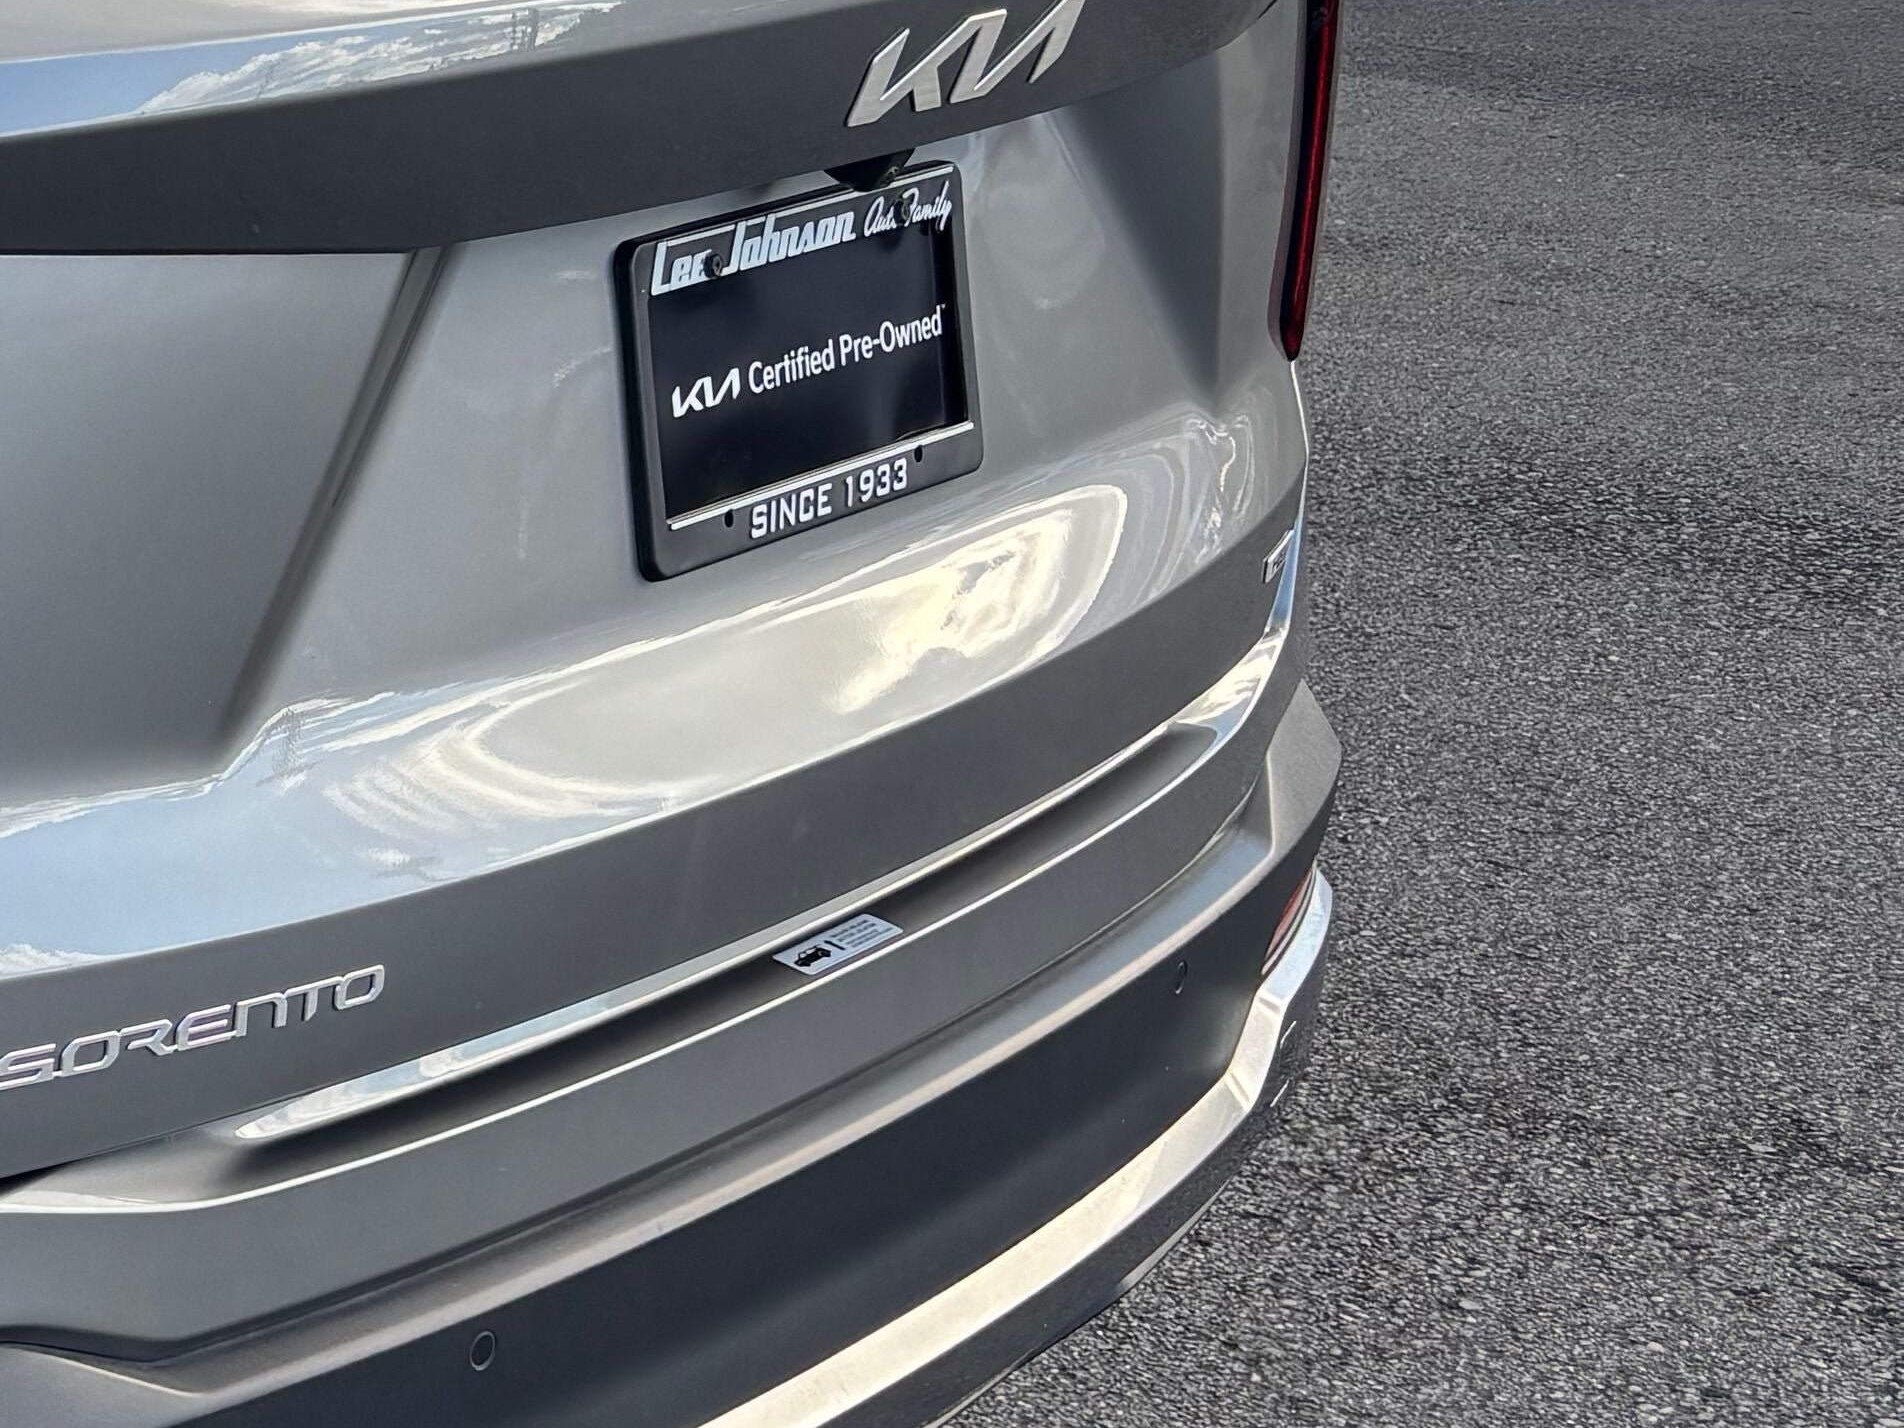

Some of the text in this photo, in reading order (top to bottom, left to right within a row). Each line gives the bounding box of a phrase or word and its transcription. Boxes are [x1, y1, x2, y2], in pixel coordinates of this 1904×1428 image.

[651, 240, 717, 296] Lee
[721, 212, 856, 277] Johnson
[903, 180, 953, 233] Family
[748, 338, 835, 394] Certified
[839, 305, 943, 366] Pre-Owned
[751, 457, 907, 539] SINCE 1933
